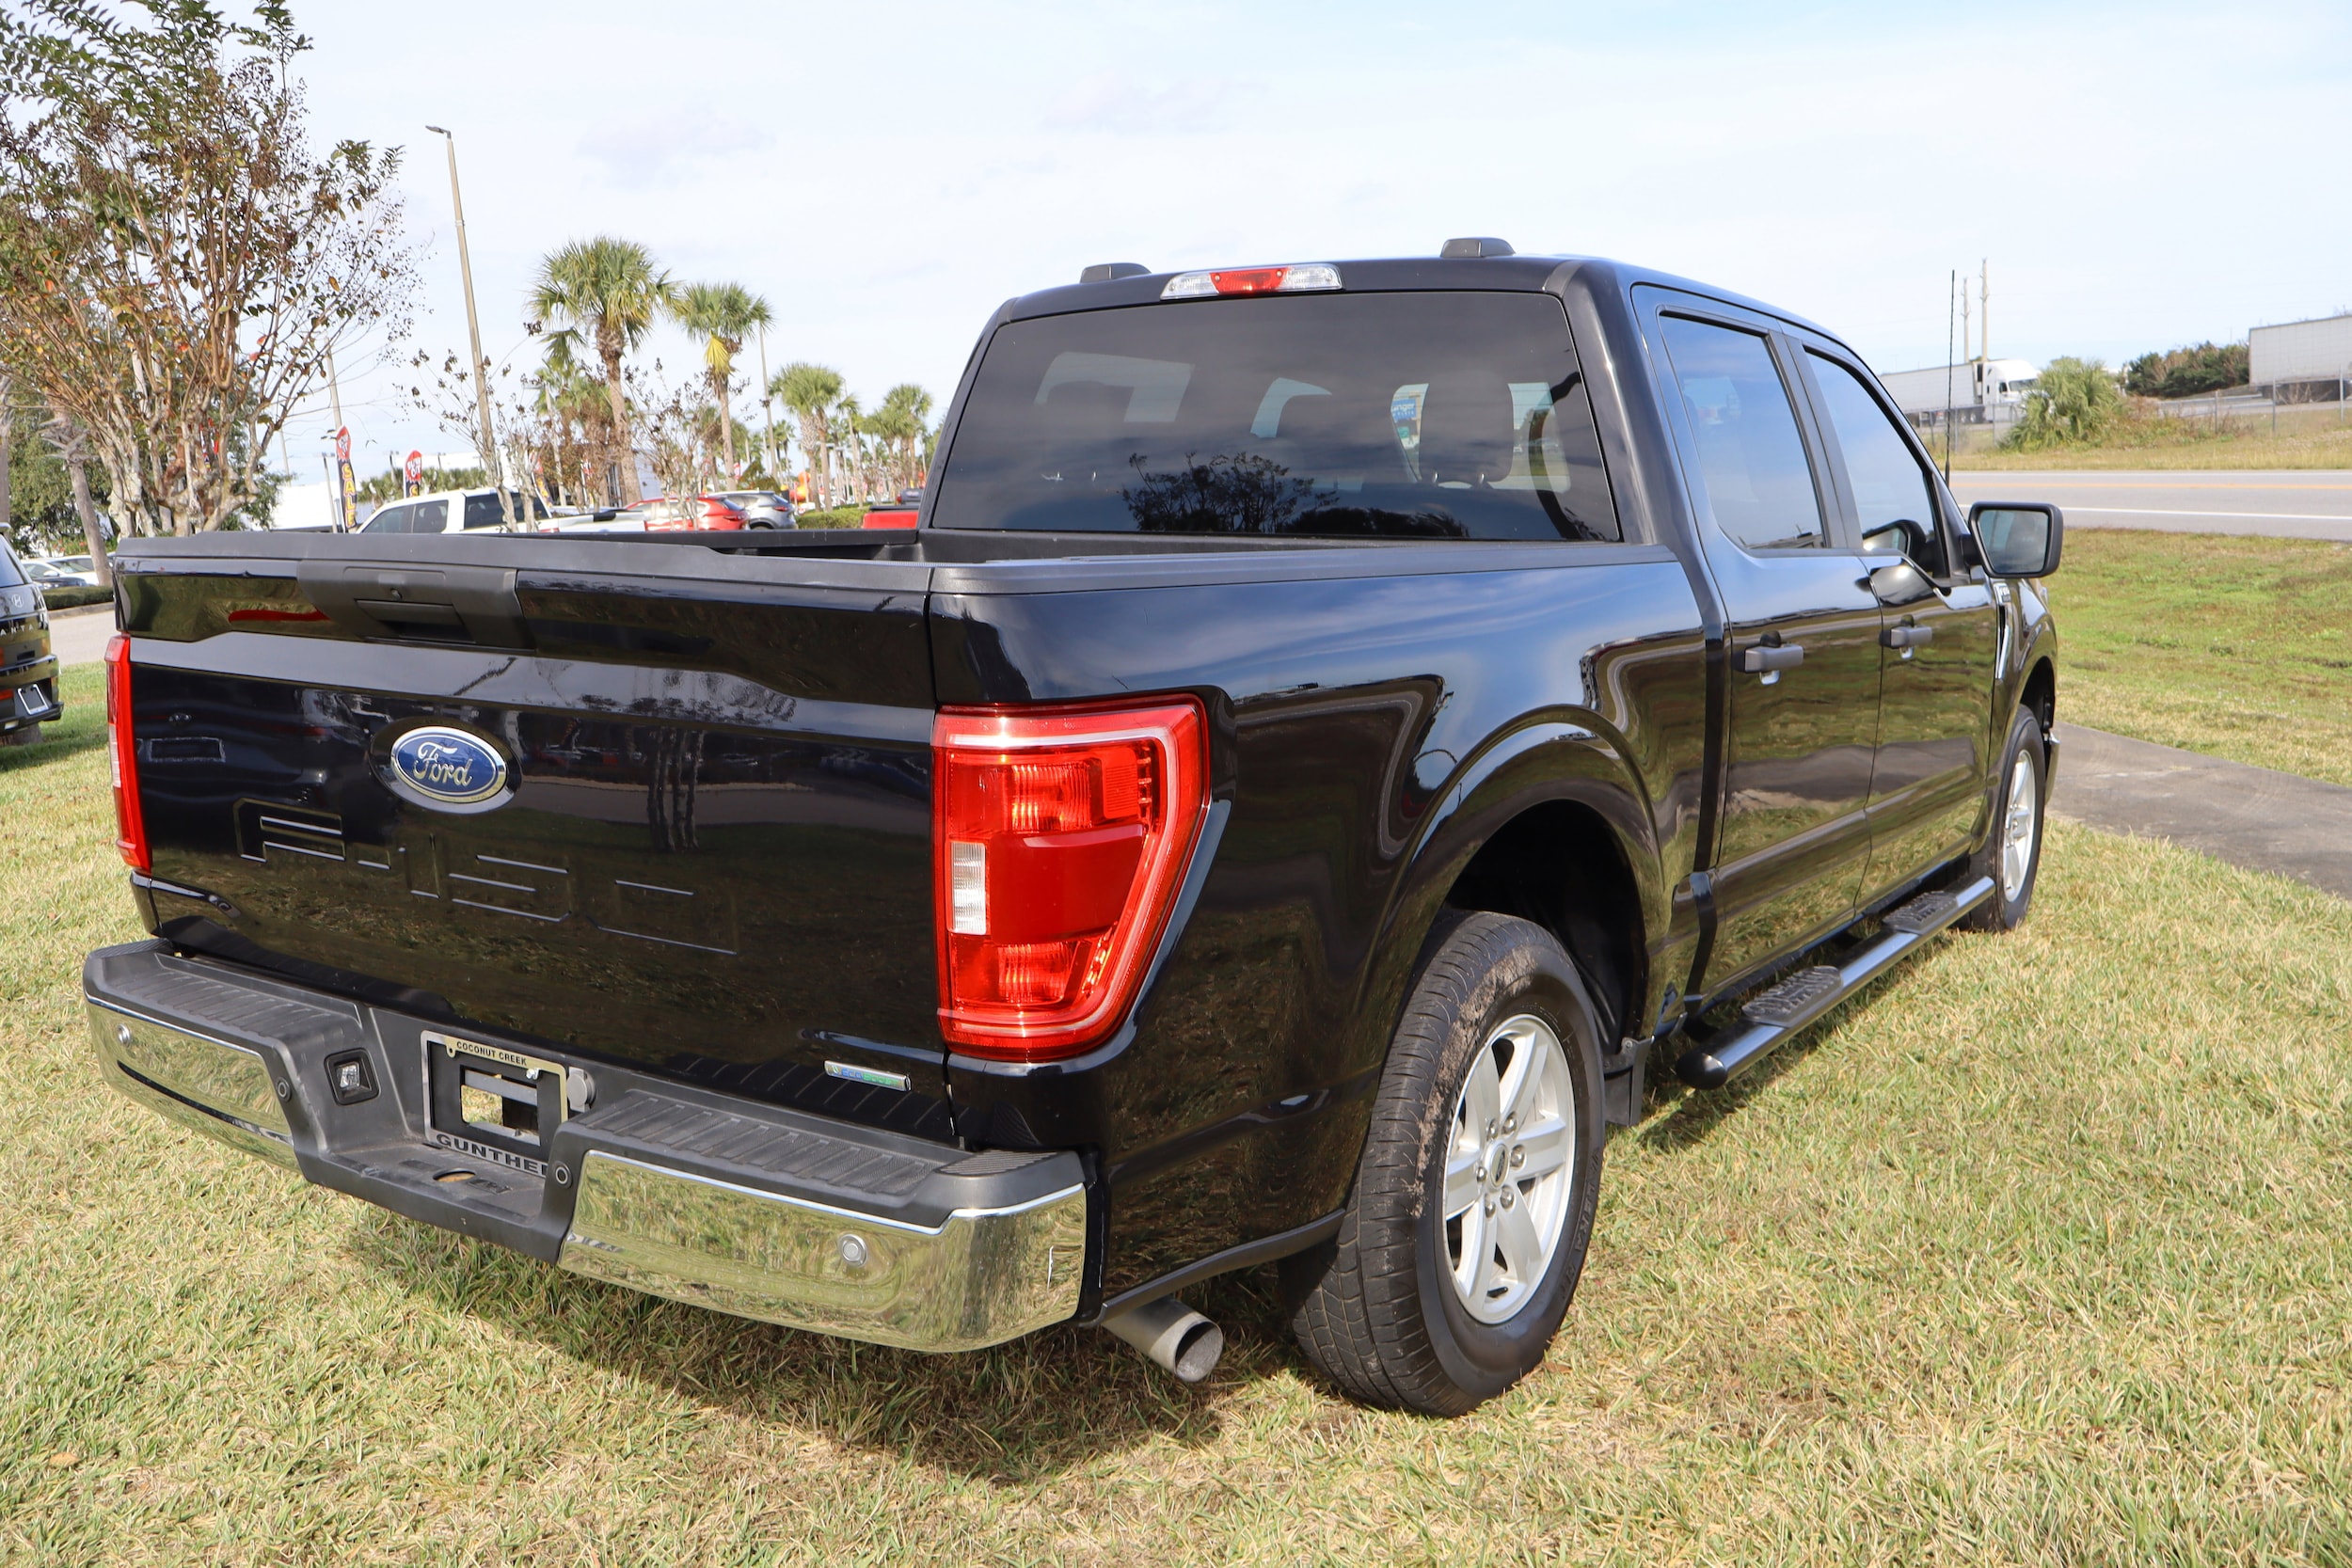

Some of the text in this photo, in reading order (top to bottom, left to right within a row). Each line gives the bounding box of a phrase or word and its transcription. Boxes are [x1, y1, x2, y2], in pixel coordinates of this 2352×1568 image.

[342, 462, 356, 528] SALE
[413, 741, 472, 787] Ford
[456, 1040, 527, 1067] COCONUT CREEK
